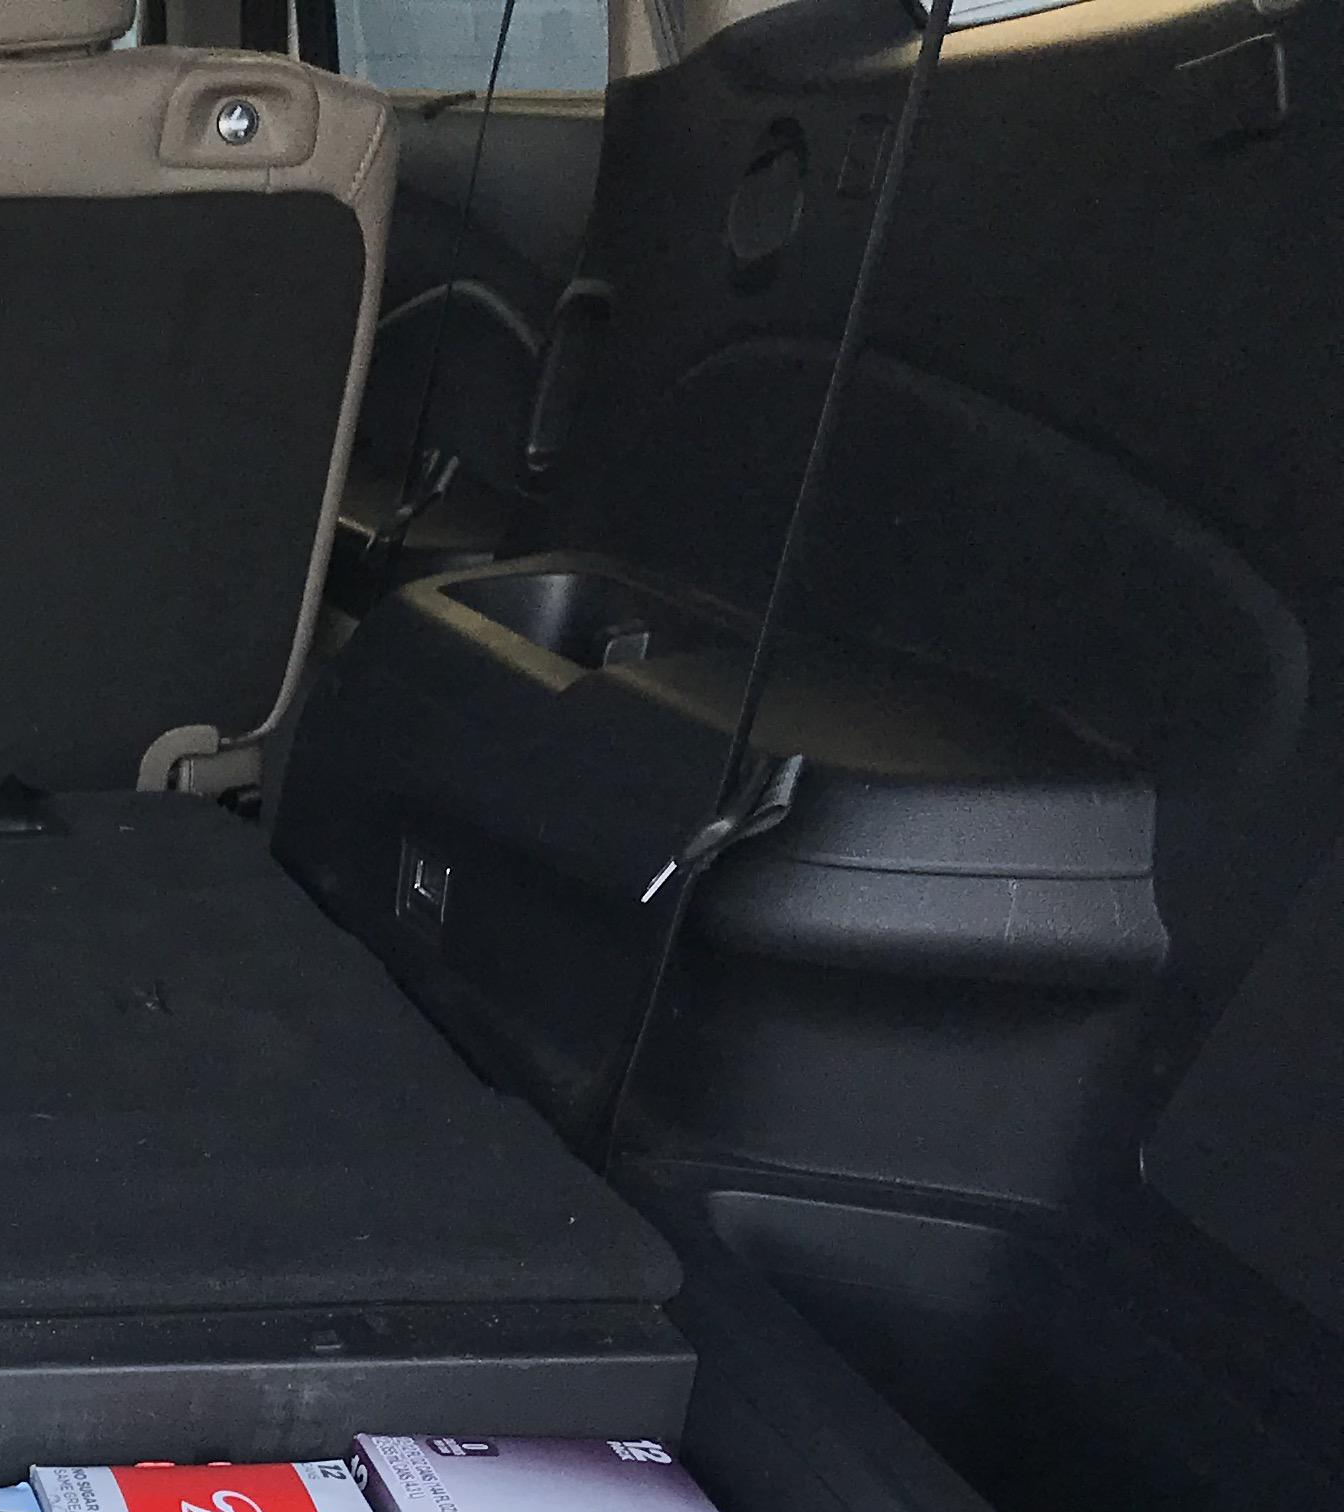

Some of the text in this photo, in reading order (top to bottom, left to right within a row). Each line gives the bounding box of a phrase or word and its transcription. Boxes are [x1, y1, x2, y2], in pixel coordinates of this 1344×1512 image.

[622, 1440, 672, 1464] 12
[53, 1468, 75, 1492] SAME
[319, 1464, 346, 1480] 12
[77, 1481, 100, 1512] SUGAR
